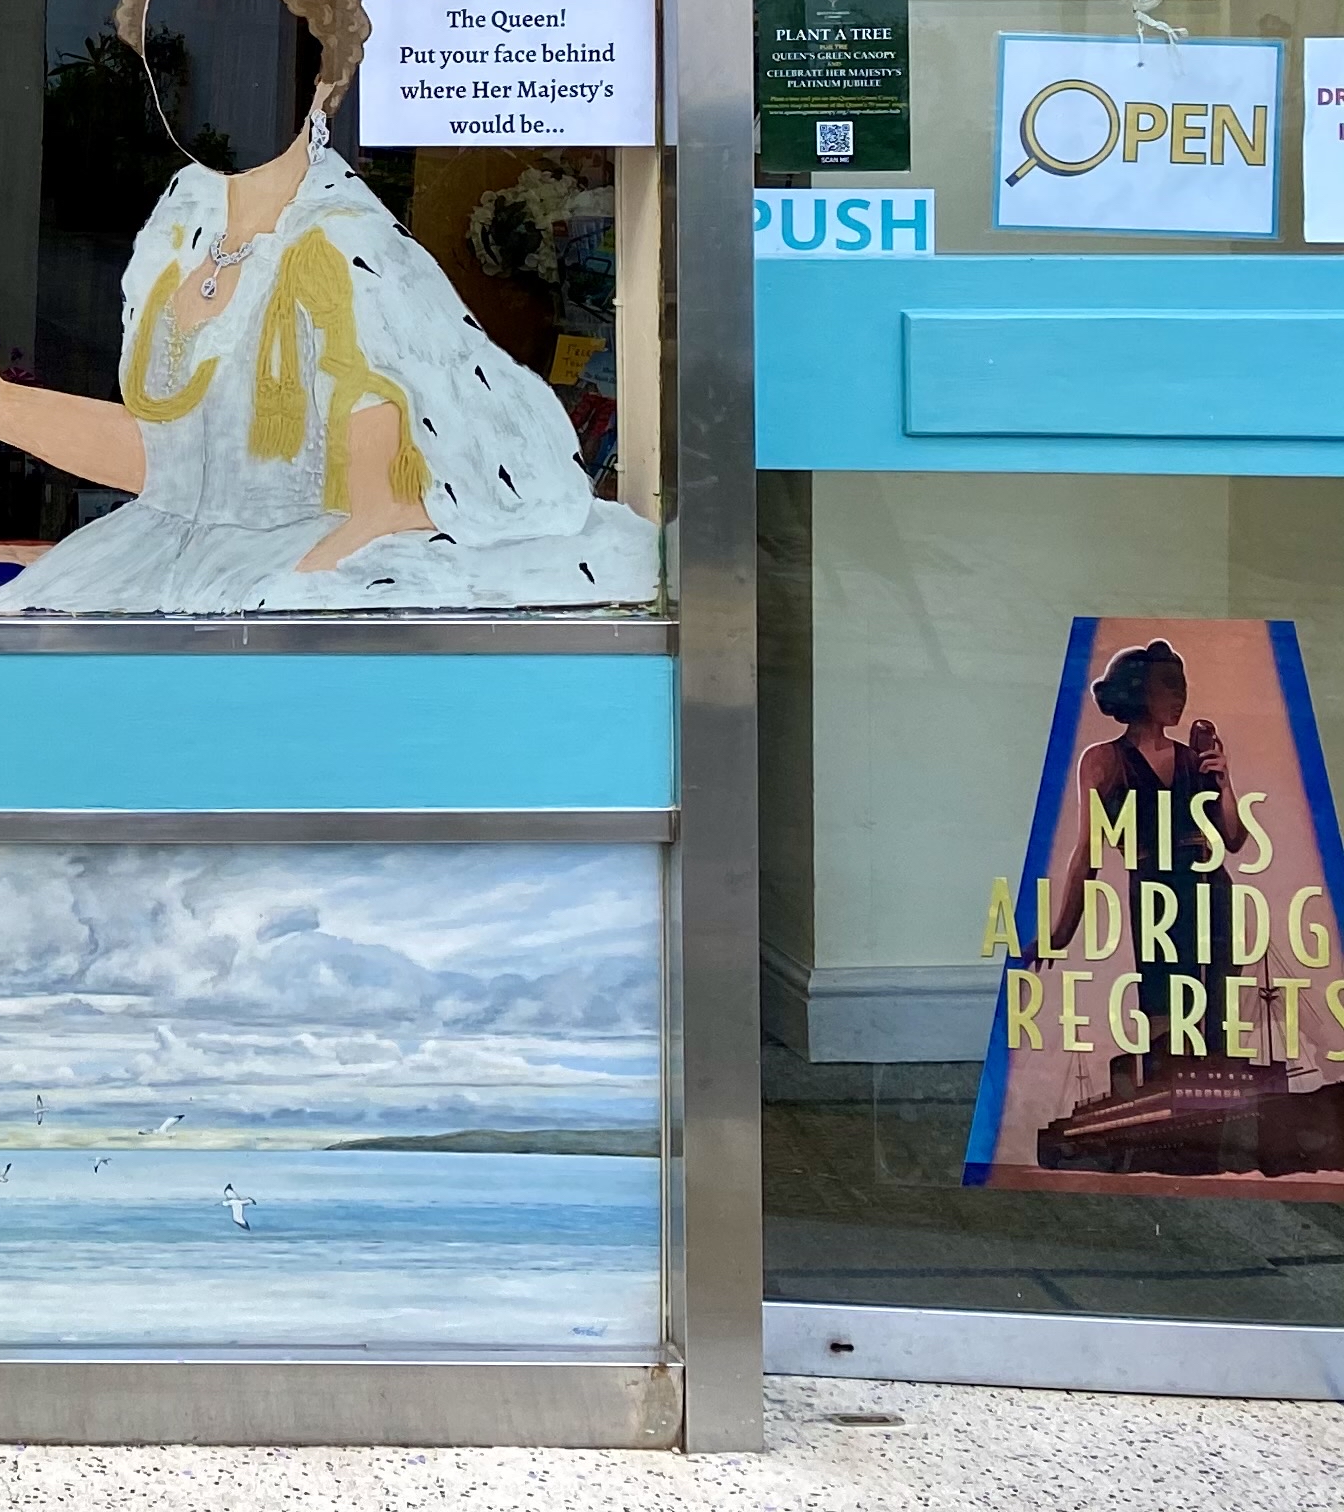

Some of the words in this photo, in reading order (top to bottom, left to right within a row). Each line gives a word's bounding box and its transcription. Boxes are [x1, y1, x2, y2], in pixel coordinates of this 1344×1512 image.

[447, 9, 486, 28] The
[491, 9, 566, 33] Queen!
[776, 28, 831, 41] PLANT
[835, 29, 847, 41] A
[850, 28, 892, 40] TREE
[399, 46, 436, 64] Put
[440, 50, 489, 69] your
[494, 43, 537, 63] face
[541, 43, 615, 63] behind
[772, 52, 815, 62] QUEEN'S
[817, 51, 851, 60] GREEN
[853, 51, 897, 59] CANOPY
[767, 69, 823, 78] CELEBRATE
[825, 69, 846, 77] HER
[848, 68, 902, 78] MAJESTY'S
[787, 79, 840, 88] PLATINUM
[843, 79, 881, 89] JUBILEE
[400, 80, 467, 99] where
[472, 80, 512, 99] Her
[517, 79, 614, 104] Majesty's
[449, 114, 515, 134] would
[520, 114, 565, 134] be...
[1005, 79, 1268, 187] OPEN
[1088, 788, 1274, 875] MISS
[1006, 969, 1344, 1061] REGRETS
